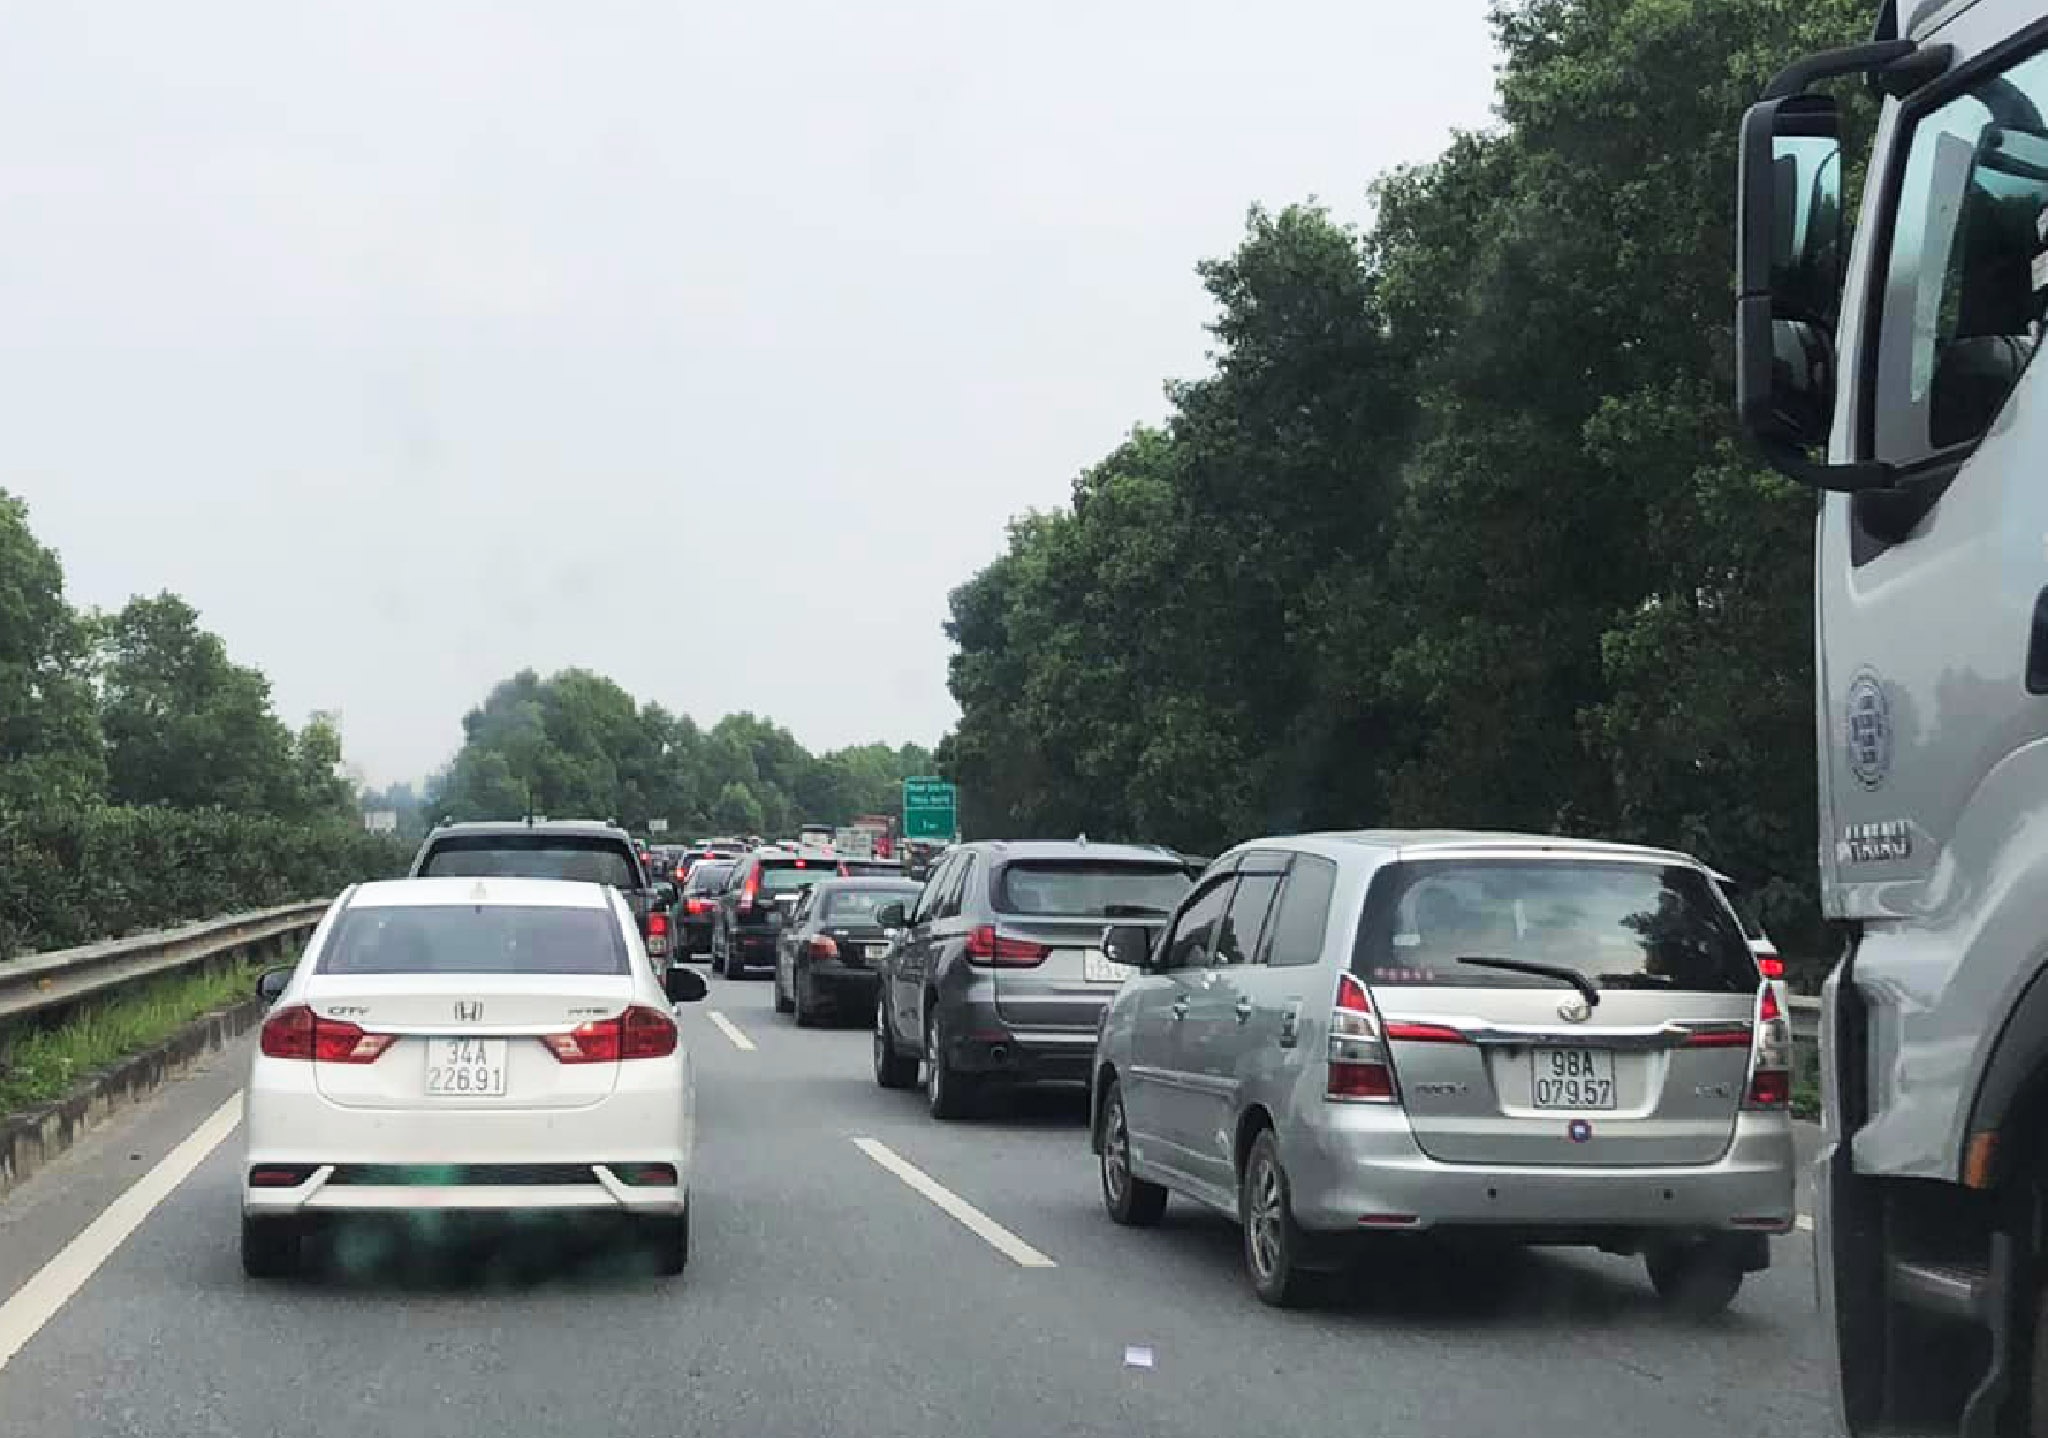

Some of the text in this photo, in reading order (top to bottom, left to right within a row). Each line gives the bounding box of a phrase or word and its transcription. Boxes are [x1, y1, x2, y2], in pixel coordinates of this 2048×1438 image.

[447, 1039, 487, 1065] 34A
[1552, 1051, 1595, 1077] 98A
[429, 1066, 500, 1091] 226.91
[1537, 1078, 1610, 1104] 079.57
